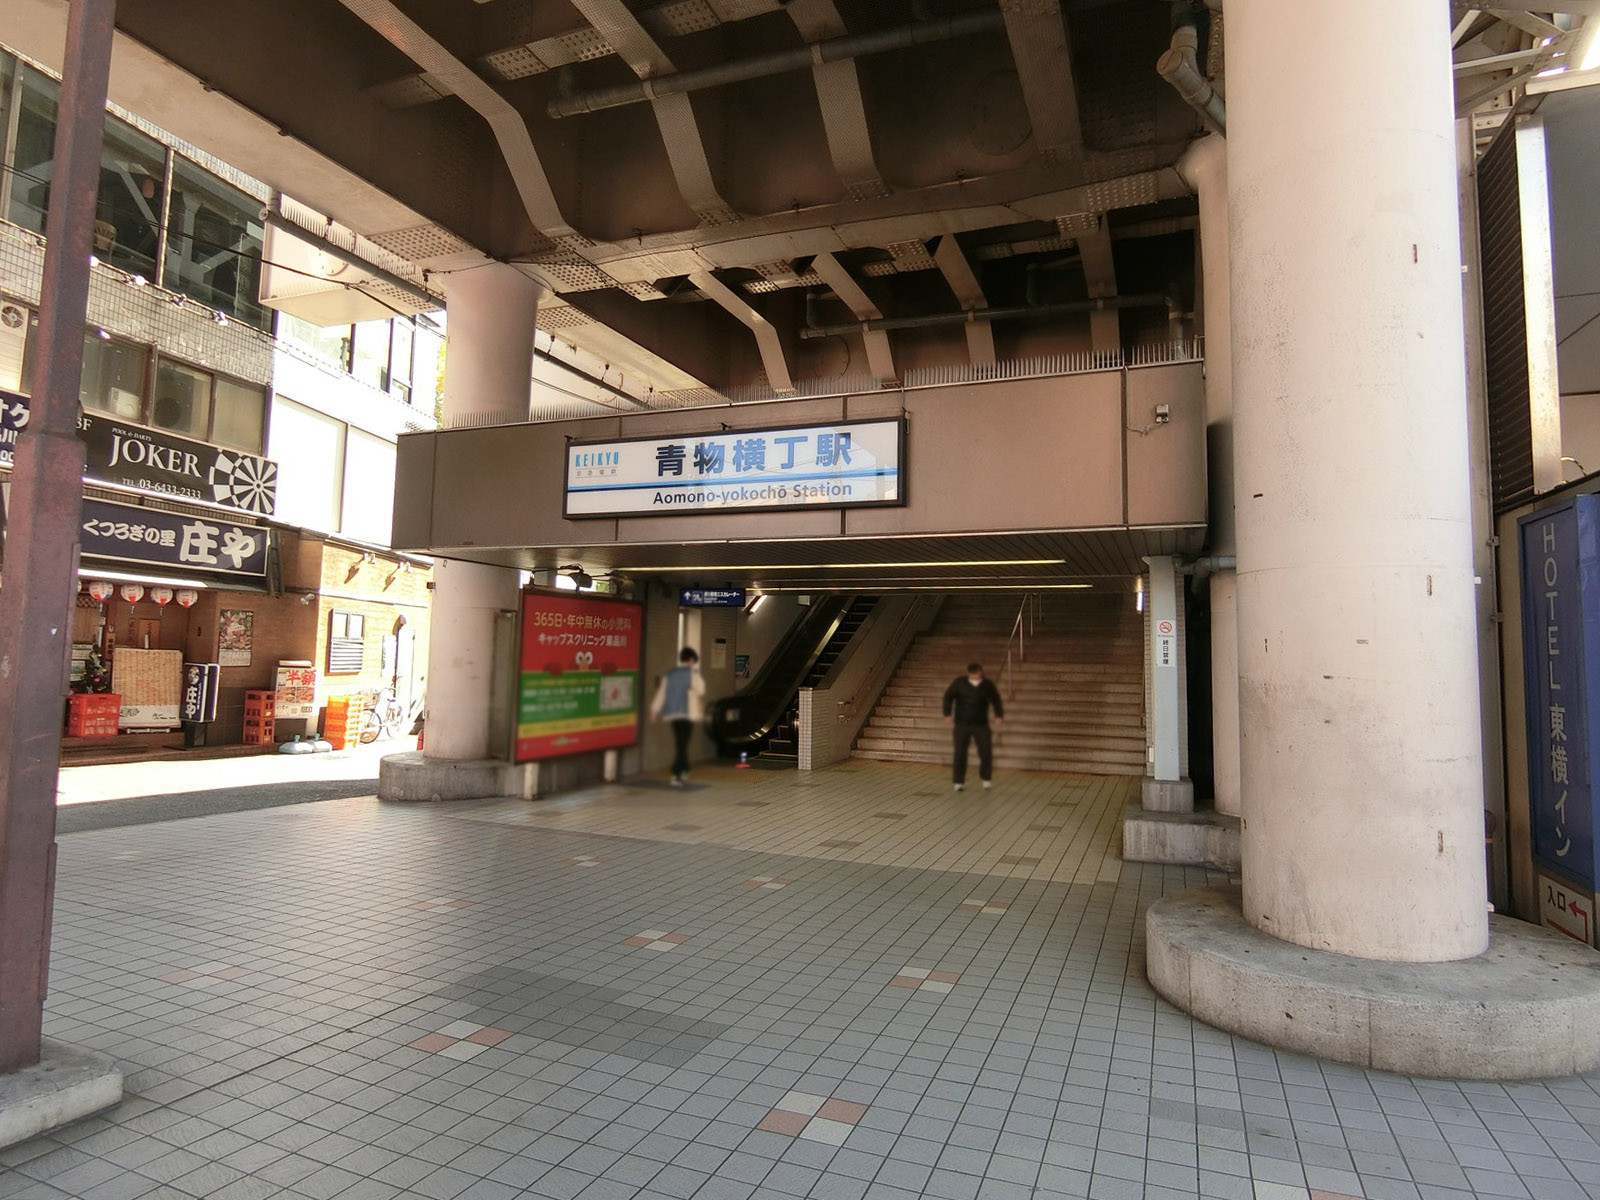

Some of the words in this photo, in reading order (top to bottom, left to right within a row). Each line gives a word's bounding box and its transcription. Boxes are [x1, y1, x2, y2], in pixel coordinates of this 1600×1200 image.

[0, 428, 18, 446] 川
[108, 434, 202, 478] JOKER
[575, 451, 619, 467] KEIKYU
[655, 432, 852, 477] 青物横丁駅
[139, 478, 201, 499] 03-6433-2333
[653, 484, 787, 505] Aomono-yokochō
[793, 482, 852, 499] Station
[83, 518, 176, 547] くつろぎの里
[179, 521, 256, 569] 庄や
[1542, 522, 1561, 690] HOTEL
[286, 669, 316, 686] 半額
[185, 685, 198, 719] 庄や
[1549, 703, 1571, 857] 東横イン
[1547, 885, 1567, 912] 入口
